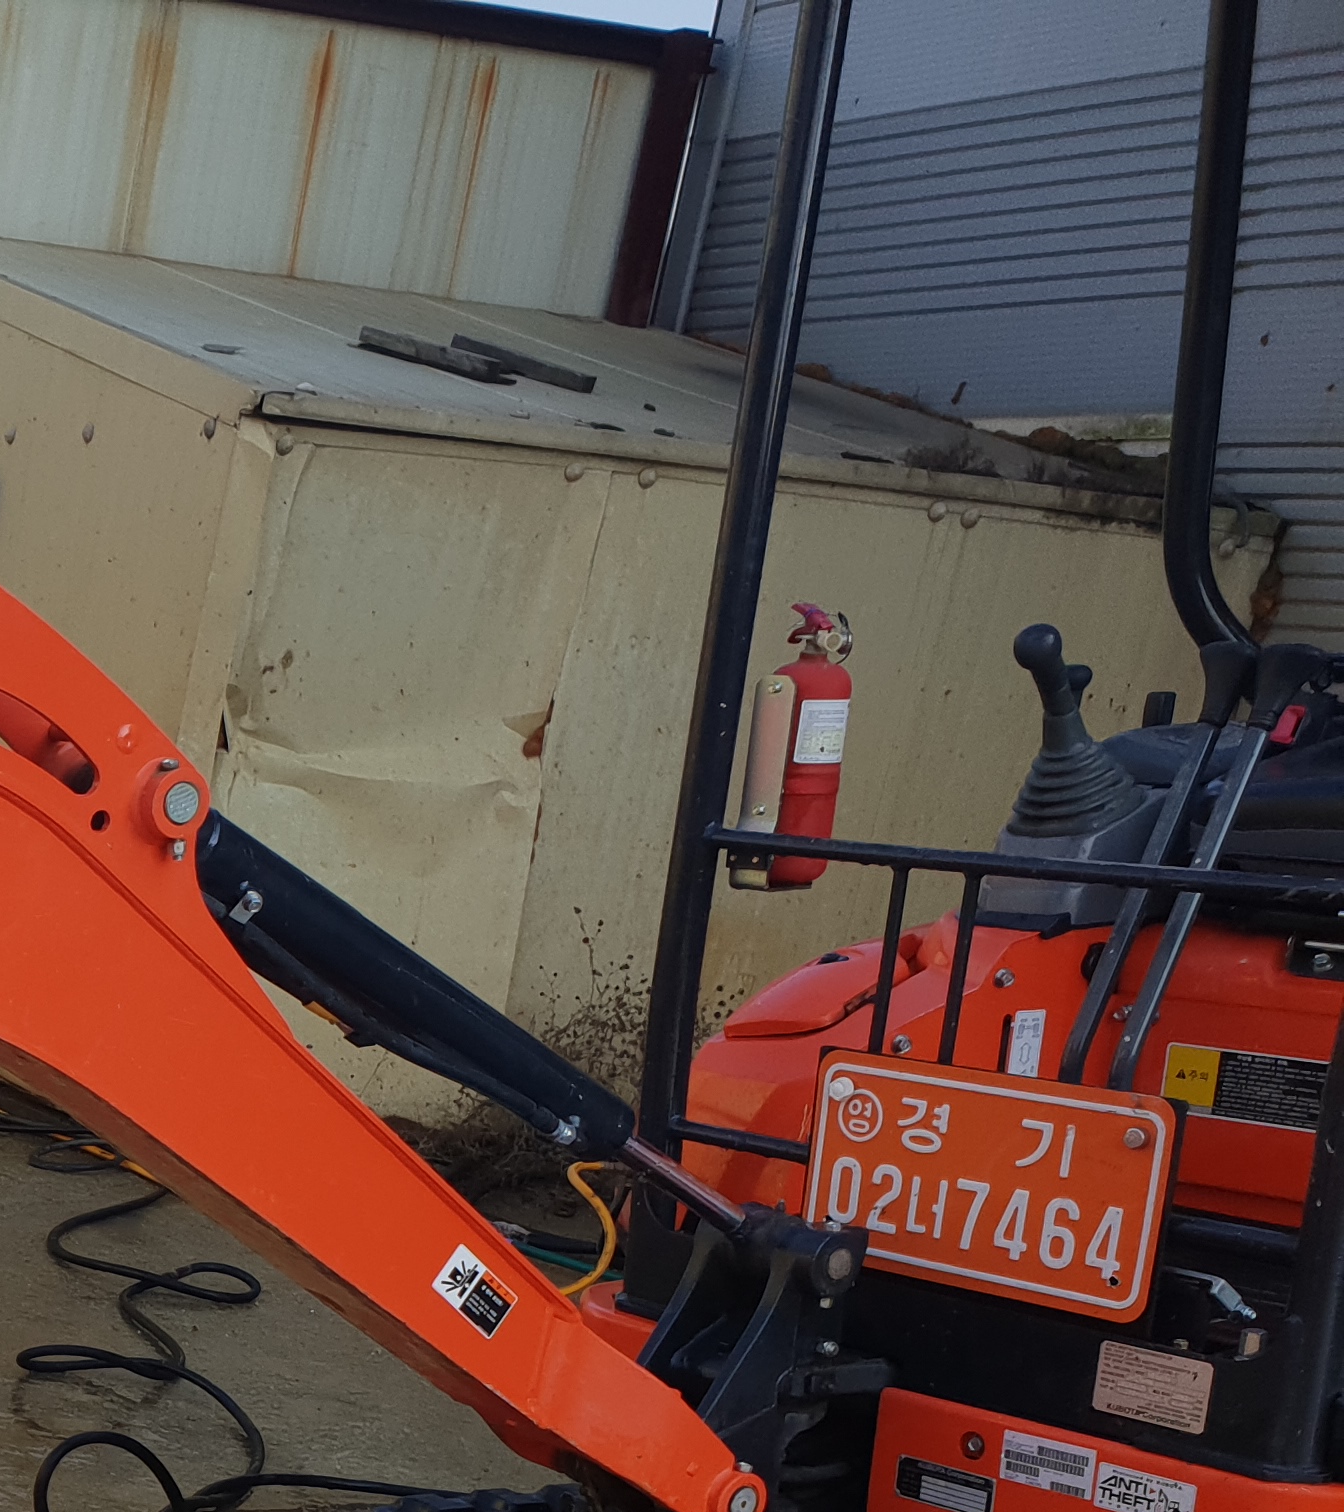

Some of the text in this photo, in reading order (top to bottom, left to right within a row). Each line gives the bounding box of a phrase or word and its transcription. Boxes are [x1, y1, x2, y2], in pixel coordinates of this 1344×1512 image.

[1188, 1068, 1210, 1083] 주의
[827, 1156, 1124, 1280] 02너7464
[1100, 1474, 1148, 1496] ANTI
[1098, 1485, 1156, 1510] THEFT
